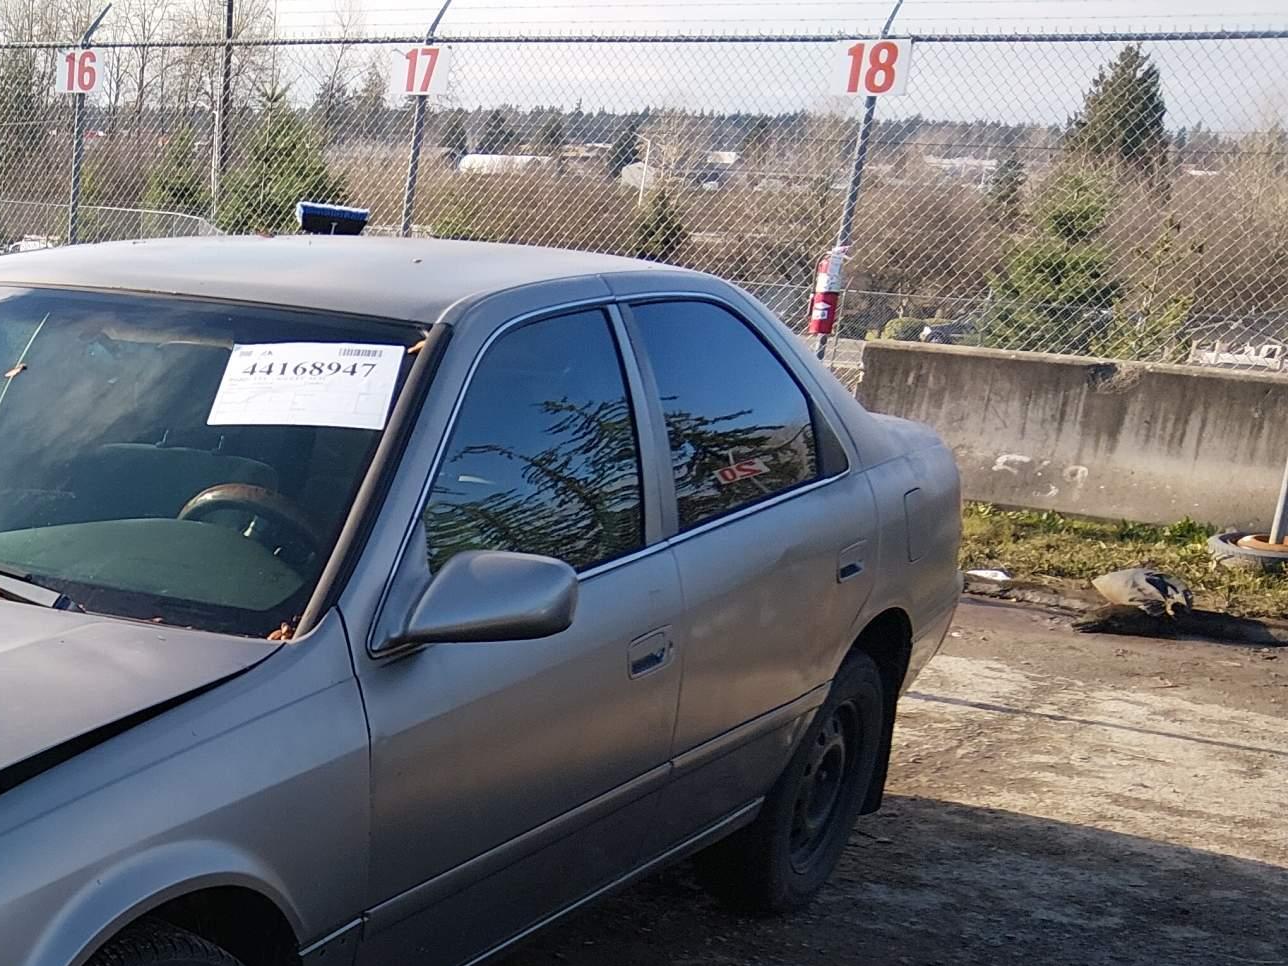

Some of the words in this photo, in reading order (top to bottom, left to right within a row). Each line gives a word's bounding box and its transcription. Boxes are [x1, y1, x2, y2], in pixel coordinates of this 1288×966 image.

[65, 51, 97, 91] 16
[405, 47, 440, 92] 17
[847, 41, 899, 94] 18
[242, 361, 377, 378] 44168947
